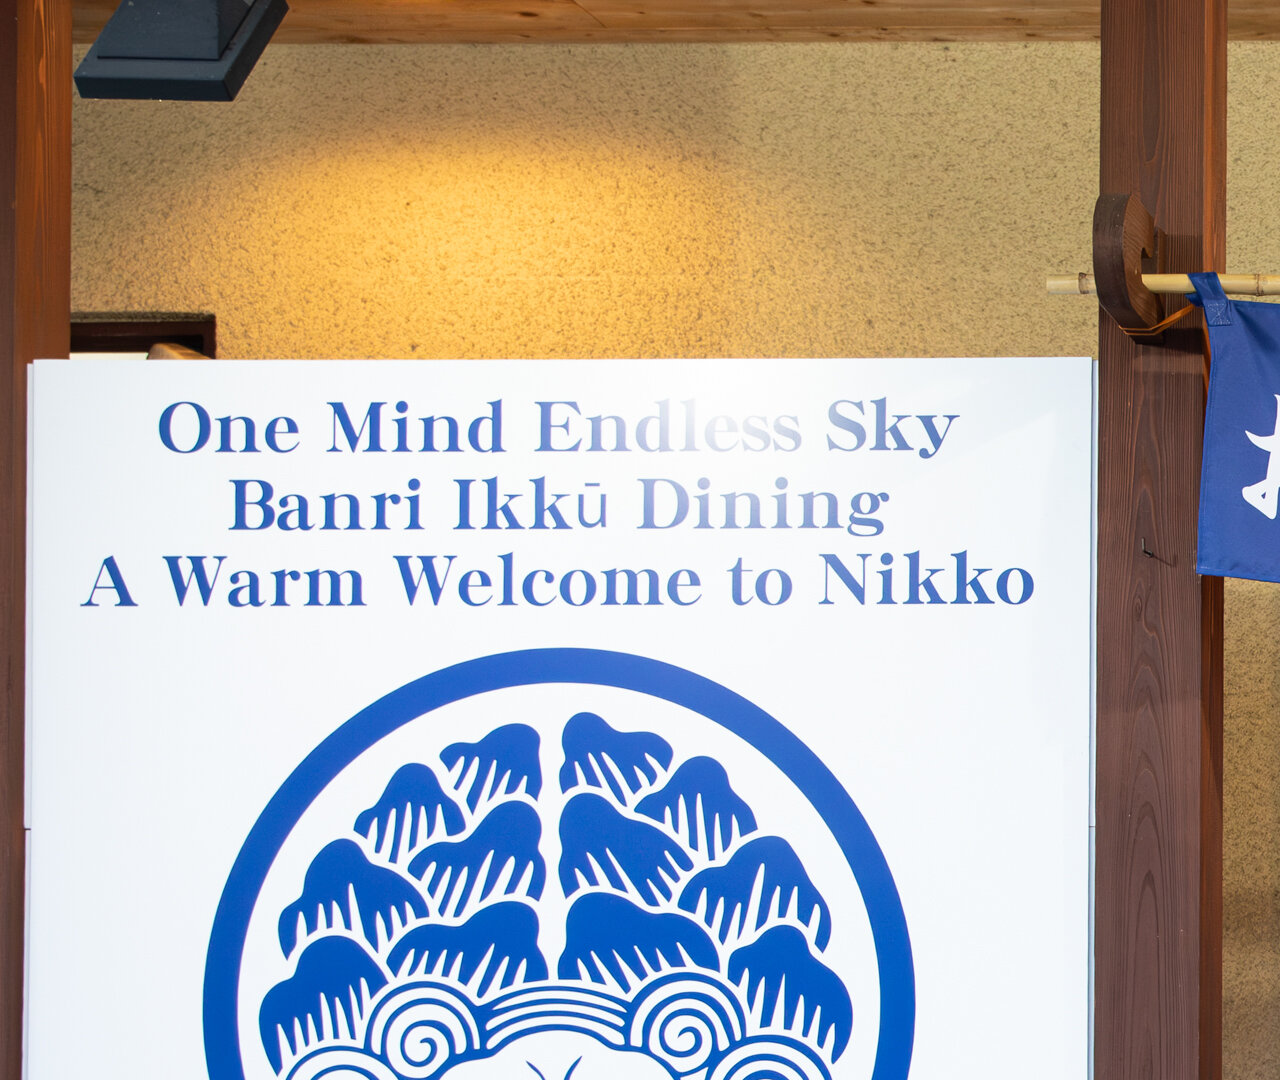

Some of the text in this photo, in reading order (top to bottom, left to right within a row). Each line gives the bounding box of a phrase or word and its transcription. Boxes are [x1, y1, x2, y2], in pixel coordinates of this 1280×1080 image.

[158, 397, 962, 461] One Mind Endless Sky
[228, 476, 892, 538] Banri Ikkū Dining
[80, 550, 1036, 609] A Warm Welcome to Nikko
